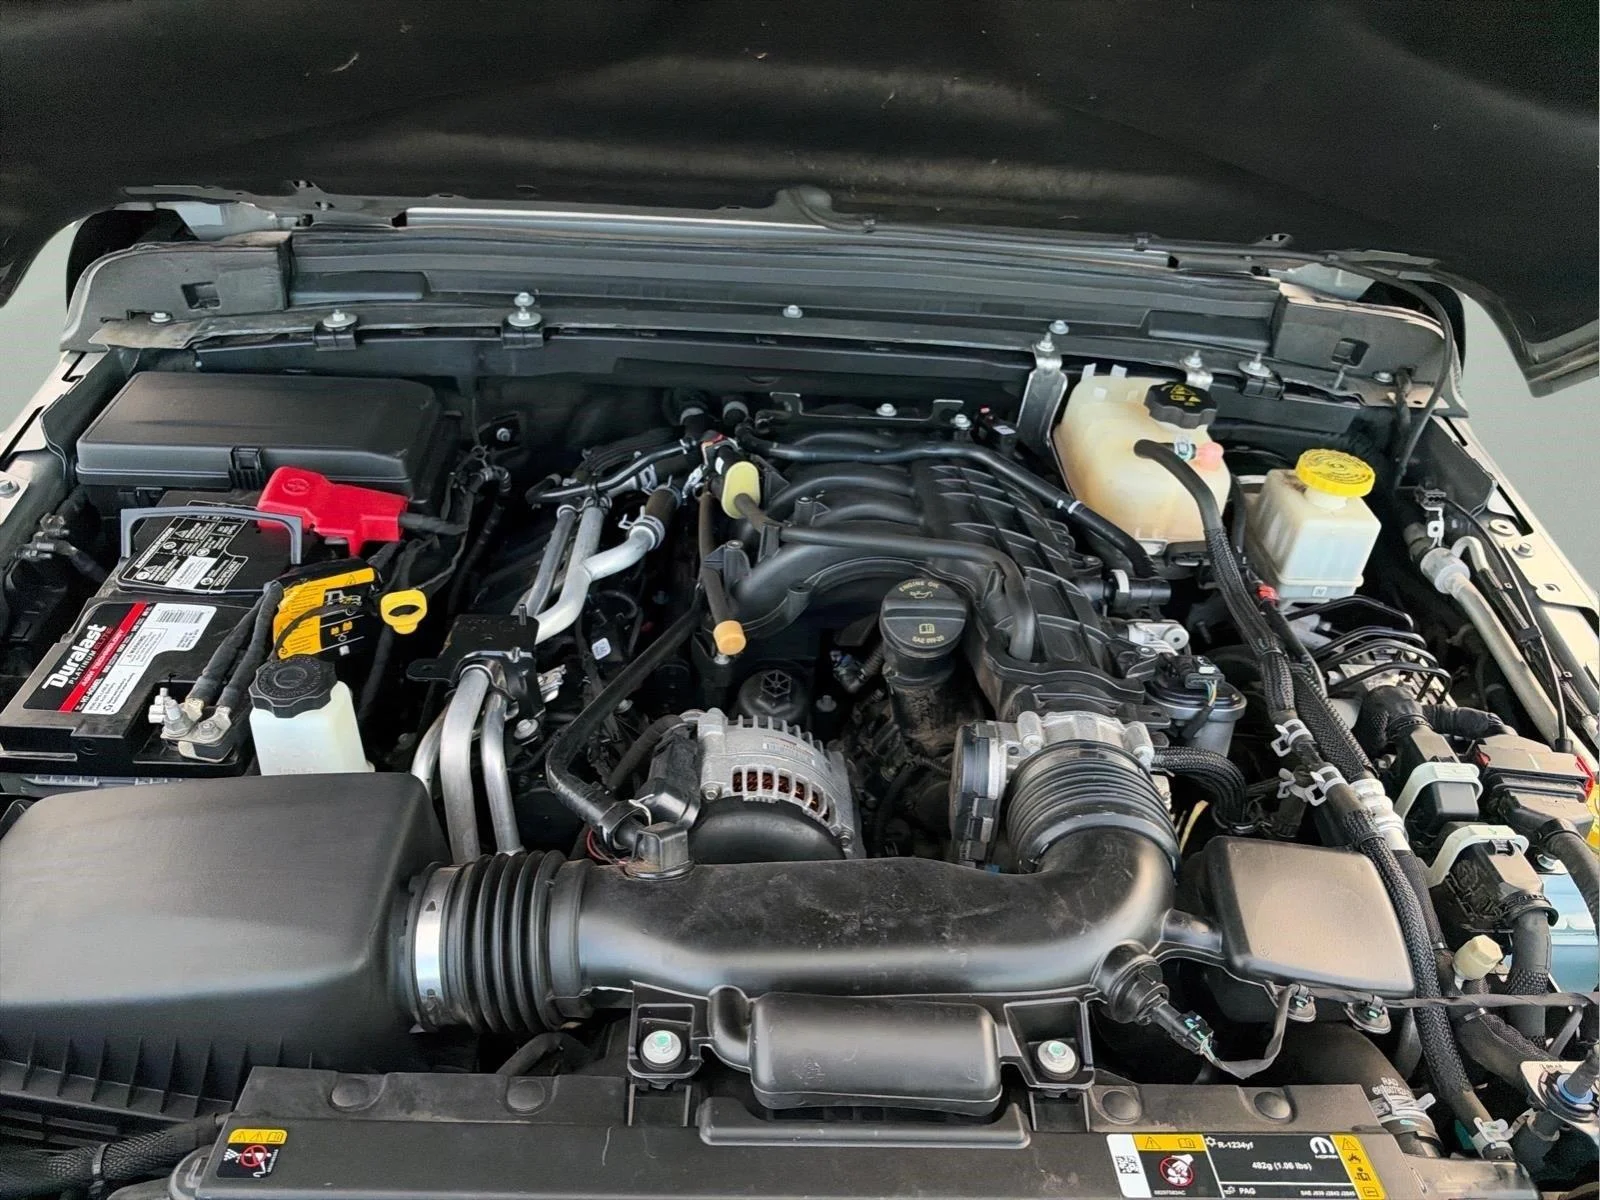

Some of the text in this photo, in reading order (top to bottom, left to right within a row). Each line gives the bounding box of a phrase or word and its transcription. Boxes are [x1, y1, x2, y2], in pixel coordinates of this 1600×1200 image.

[42, 624, 107, 689] Duralast
[68, 650, 97, 685] PLATINUM
[92, 629, 125, 670] TECHNOLOGY
[1238, 1187, 1256, 1195] PAG
